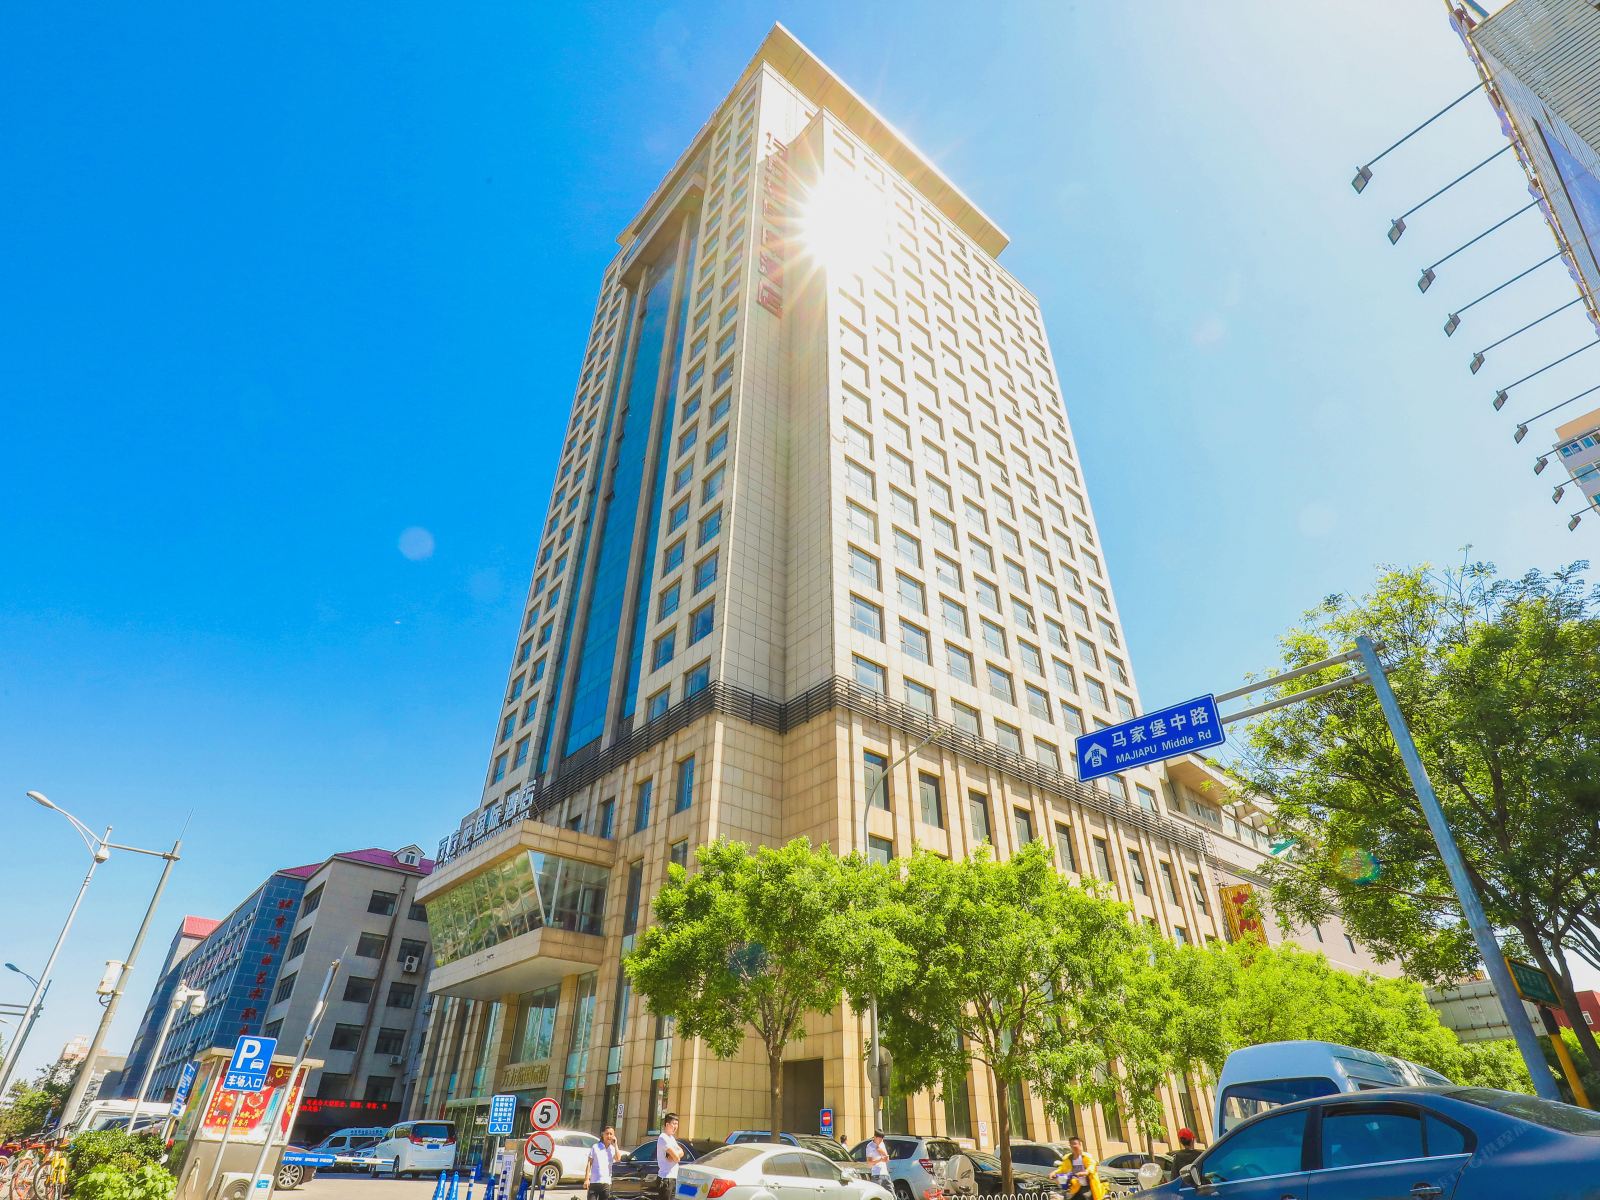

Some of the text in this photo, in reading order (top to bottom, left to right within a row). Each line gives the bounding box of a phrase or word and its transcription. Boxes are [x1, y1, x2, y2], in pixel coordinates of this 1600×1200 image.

[1111, 706, 1209, 747] 马家堡中路
[1091, 748, 1100, 757] 南
[1115, 729, 1212, 764] MAJIAPU Middle Rd
[1093, 757, 1099, 765] S
[235, 1039, 261, 1069] P
[226, 1074, 262, 1088] 车场入口
[538, 1105, 552, 1124] 5
[493, 1123, 508, 1132] 入口
